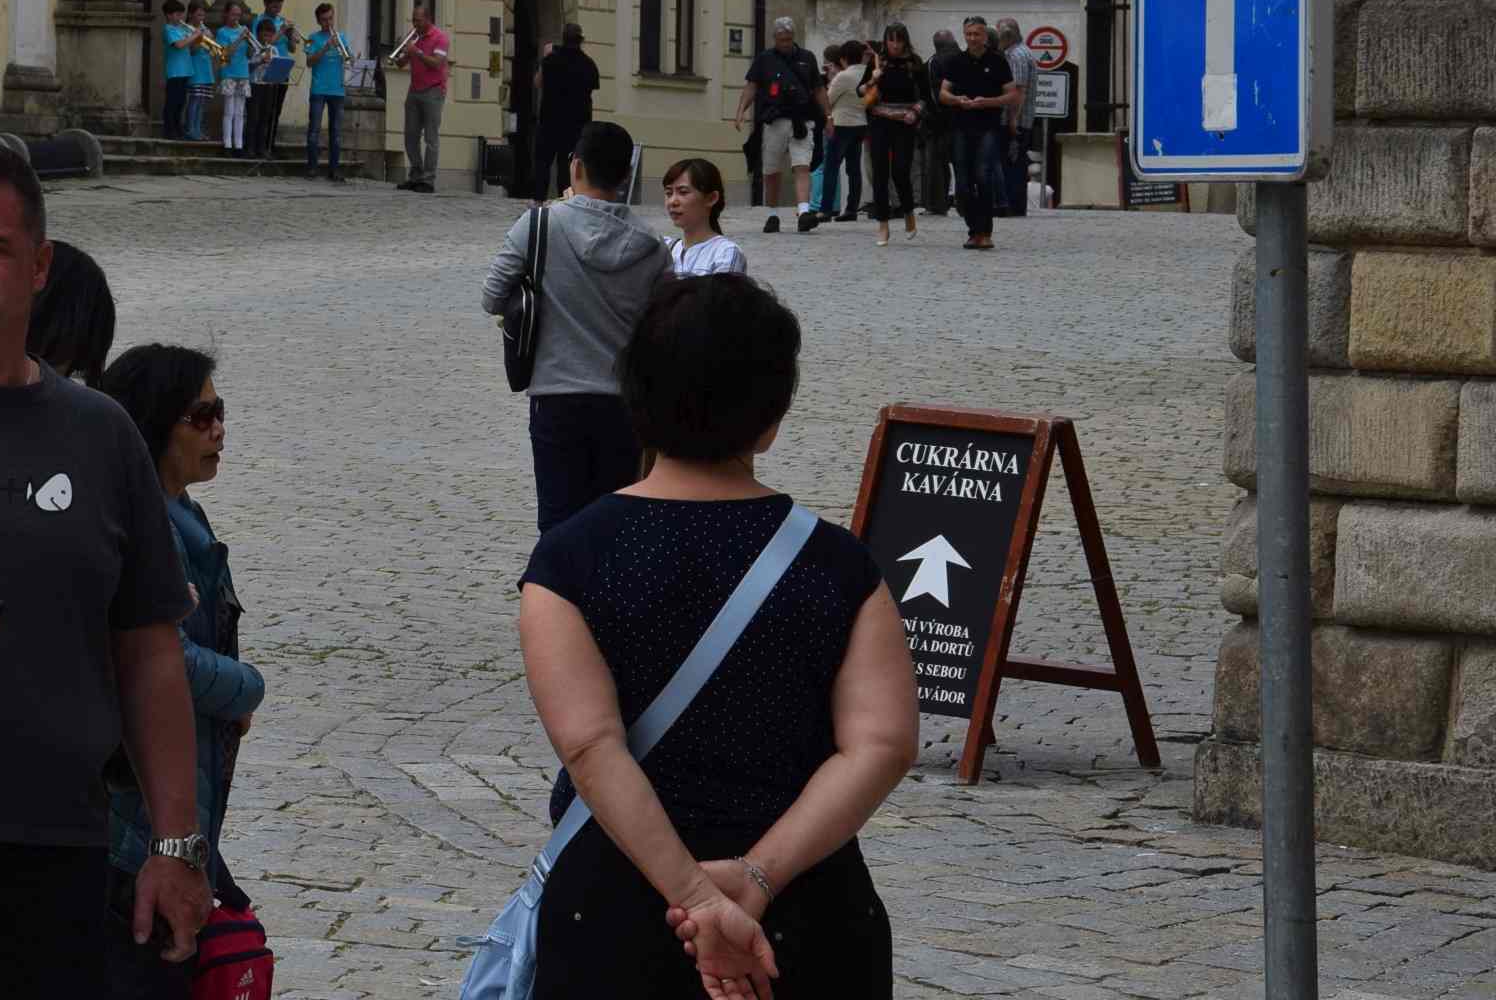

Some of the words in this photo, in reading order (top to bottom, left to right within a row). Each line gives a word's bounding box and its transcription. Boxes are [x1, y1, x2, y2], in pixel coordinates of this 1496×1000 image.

[896, 441, 1019, 475] CUKRÁRNA
[901, 471, 1003, 502] KAVÁRNA
[901, 616, 919, 633] NÍ
[919, 619, 970, 639] VÝROBA
[919, 640, 929, 652] A
[930, 640, 975, 657] DORTŮ
[925, 663, 968, 680] SEBOU
[917, 685, 966, 705] LVÁDOR
